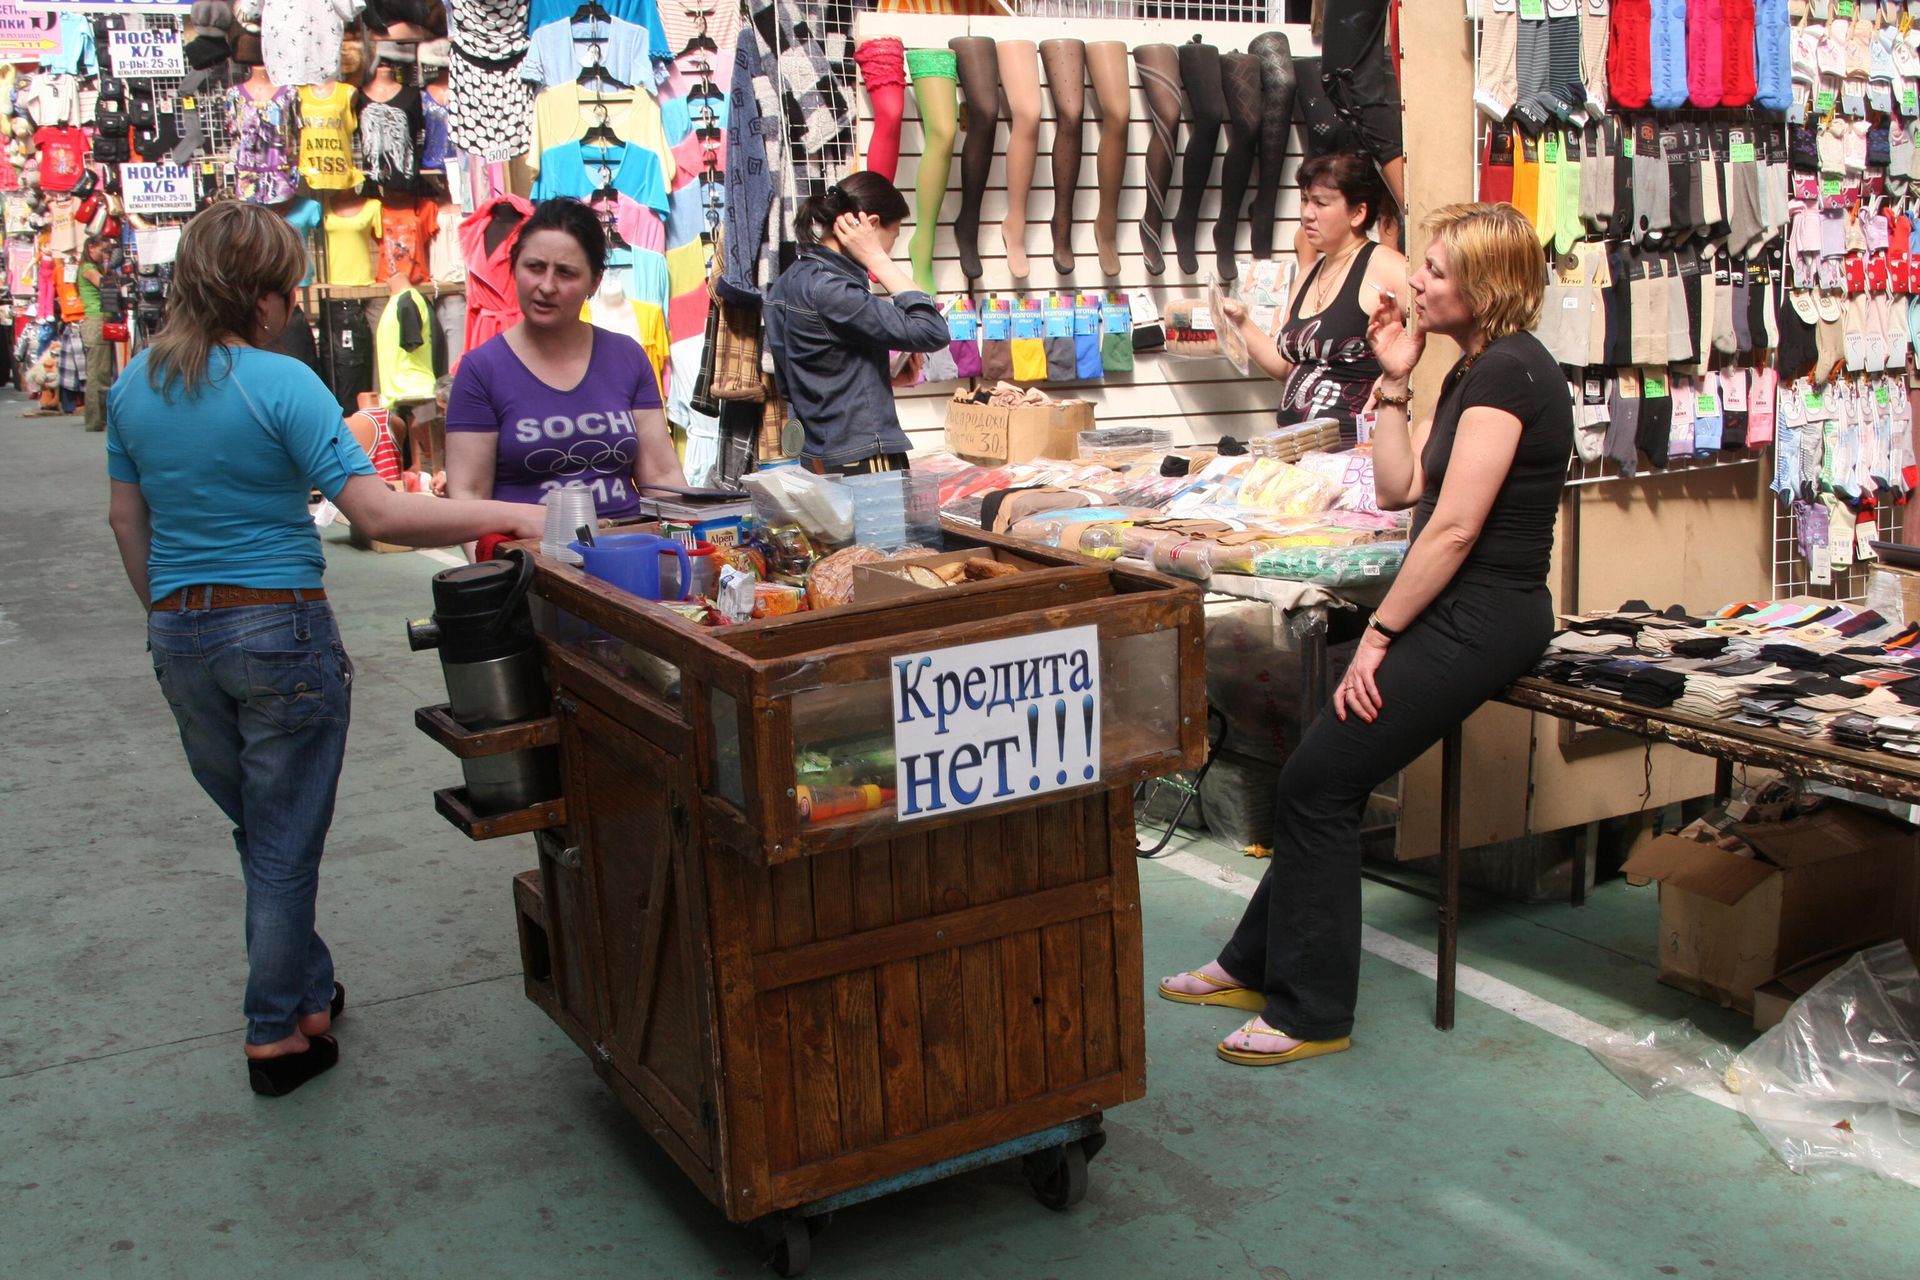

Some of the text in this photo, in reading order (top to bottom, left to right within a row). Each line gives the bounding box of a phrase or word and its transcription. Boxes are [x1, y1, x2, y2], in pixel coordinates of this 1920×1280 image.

[114, 32, 177, 44] НОСКИ
[131, 45, 164, 57] Х/Б
[151, 59, 179, 68] 25-31
[489, 148, 508, 161] 500
[127, 166, 188, 179] НОСКИ
[143, 180, 175, 193] Х/Б
[169, 194, 188, 202] 25-31
[516, 410, 638, 442] SOCHI
[538, 478, 627, 504] 214
[710, 534, 734, 544] Alpen
[894, 649, 1094, 735] Кредита
[900, 693, 1094, 815] нет!!!
